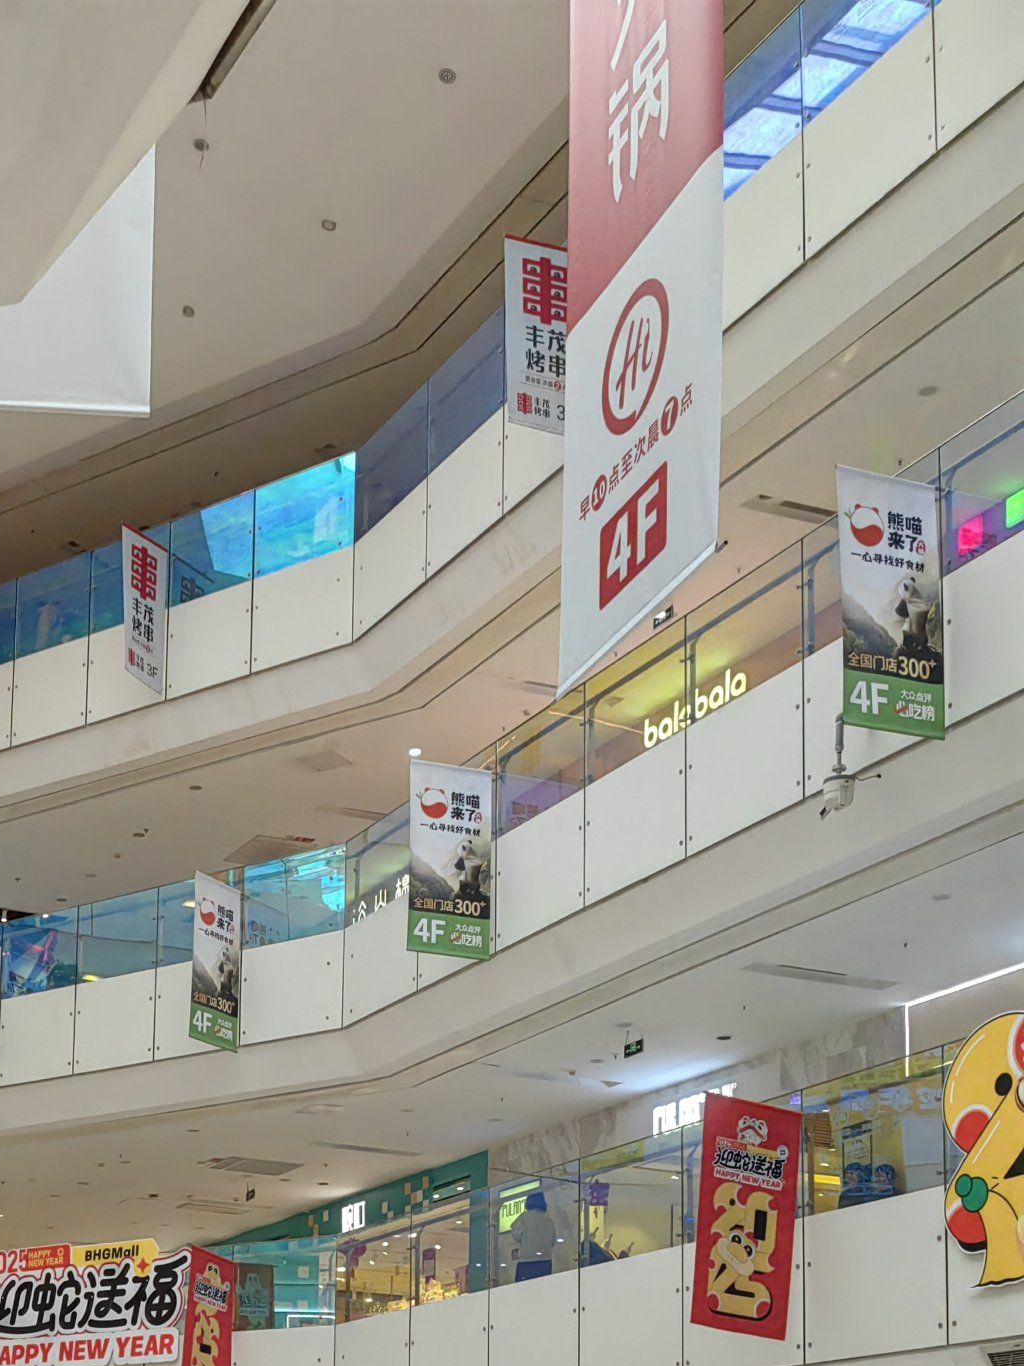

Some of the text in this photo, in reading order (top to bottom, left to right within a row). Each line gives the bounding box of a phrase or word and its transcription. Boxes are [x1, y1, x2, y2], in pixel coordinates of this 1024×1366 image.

[525, 325, 566, 353] 丰茂
[525, 347, 566, 379] 烤串
[606, 478, 661, 587] 4F
[887, 511, 923, 536] 熊喵
[887, 531, 919, 553] 来了
[851, 551, 925, 573] 一心寻找好食材
[146, 662, 159, 679] 3F
[643, 668, 746, 748] balabala
[849, 680, 890, 715] 4F
[900, 690, 932, 703] 大众点评
[451, 791, 480, 809] 熊喵
[450, 807, 475, 822] 来了
[413, 917, 447, 944] 4F
[192, 1009, 213, 1034] 4F
[714, 1147, 786, 1179] 迎蛇送福
[716, 1169, 781, 1188] HAPPY NEW YEAR
[28, 1250, 51, 1260] HAPPY
[28, 1255, 64, 1268] NEW YEAR
[84, 1244, 140, 1261] BHGMall
[58, 1338, 110, 1363] NEW
[116, 1333, 174, 1358] YEAR
